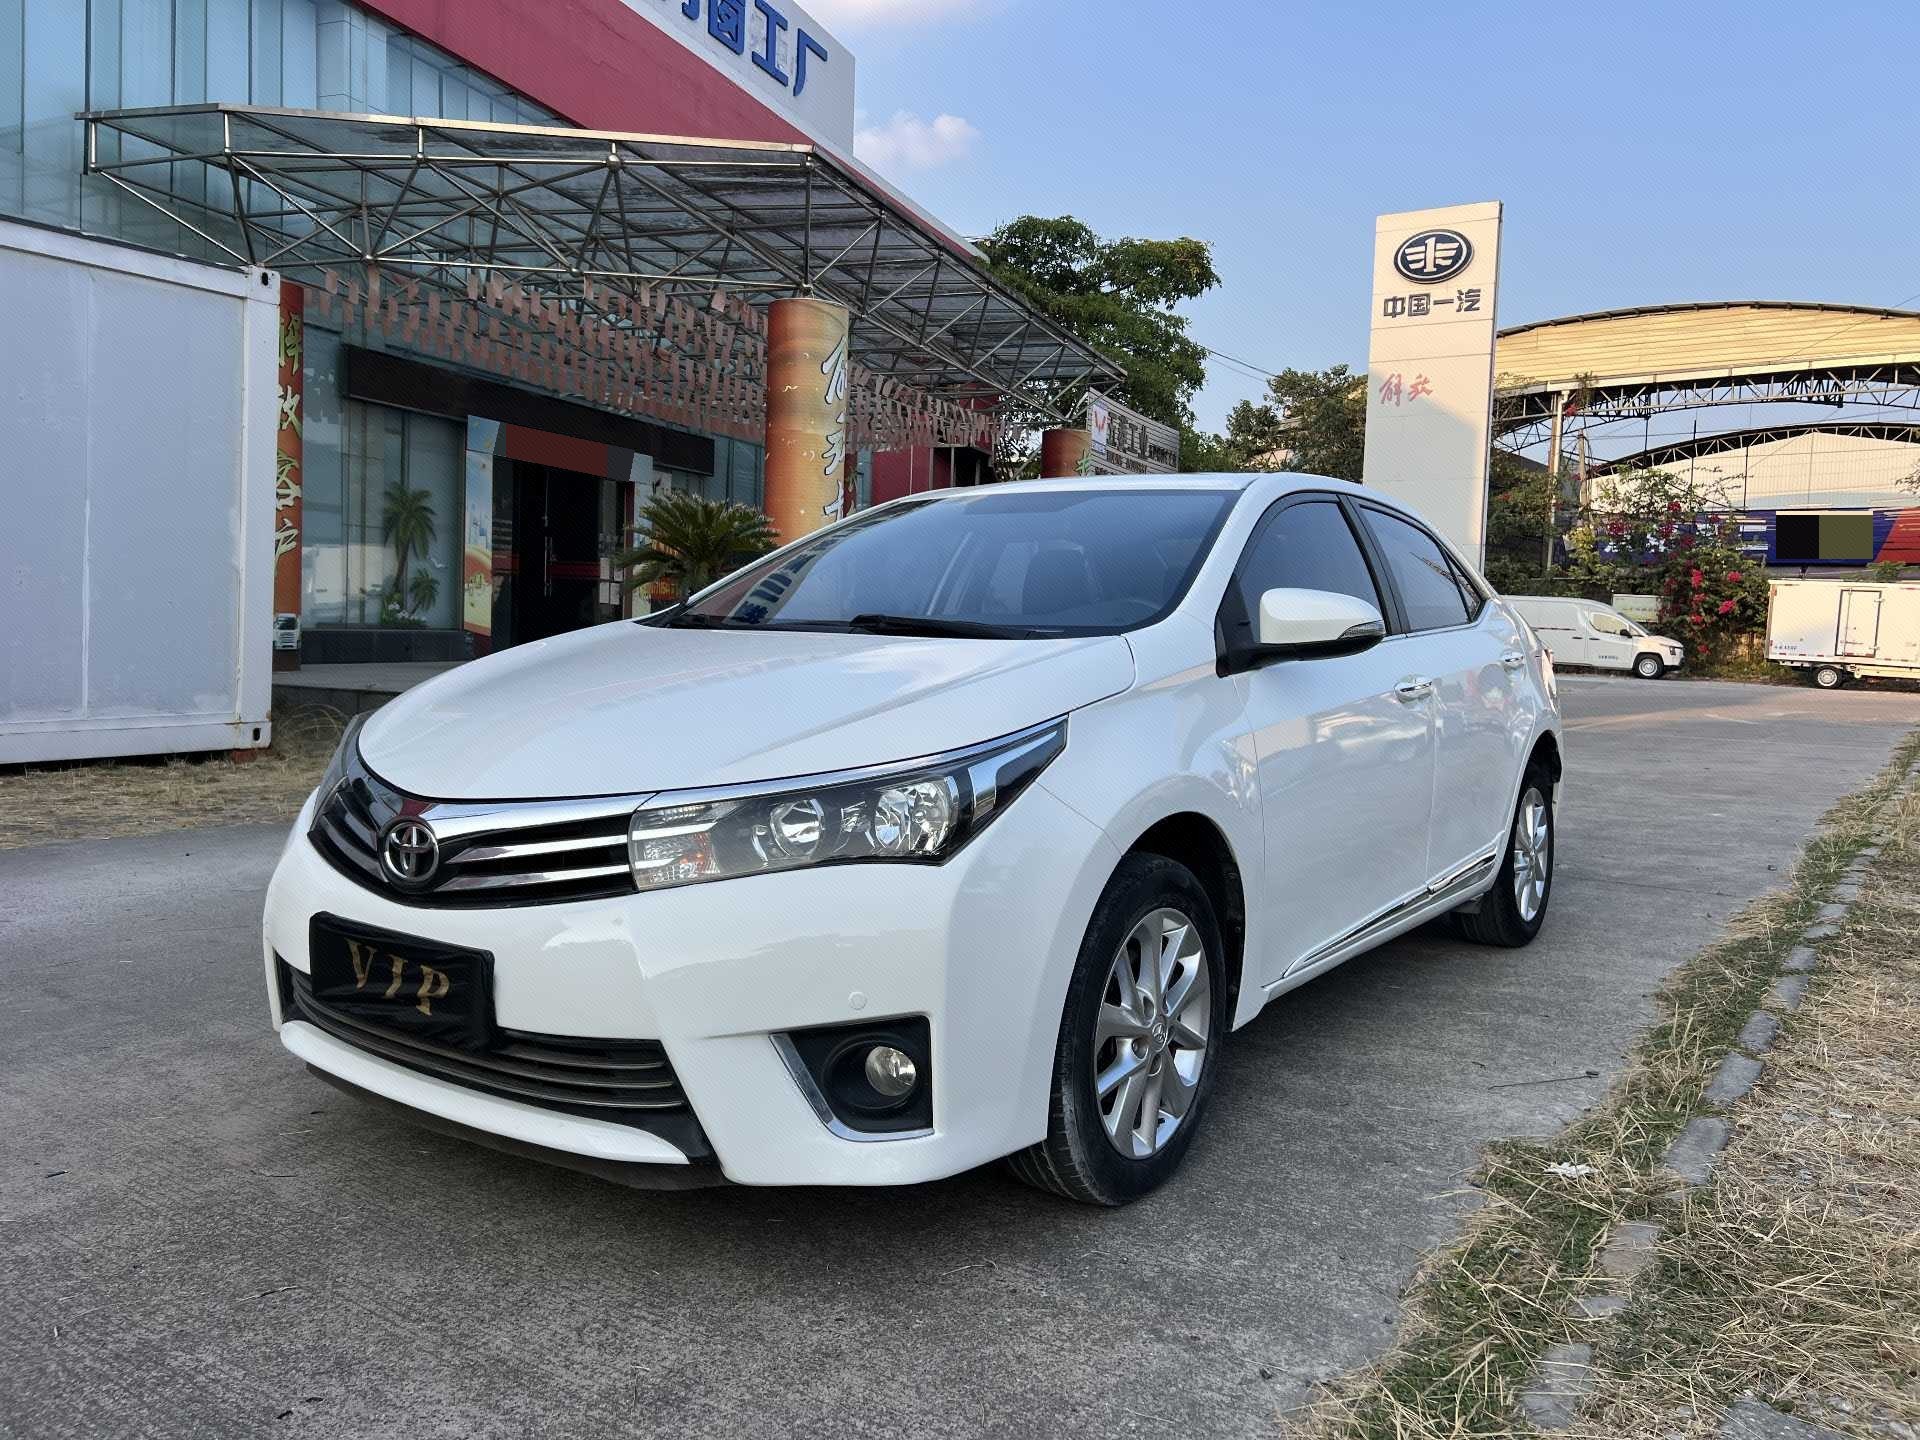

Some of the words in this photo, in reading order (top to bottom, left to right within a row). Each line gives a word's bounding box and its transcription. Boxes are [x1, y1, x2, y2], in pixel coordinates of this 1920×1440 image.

[681, 0, 828, 97] 窗工厂
[1383, 288, 1481, 318] 中国一汽
[1379, 373, 1433, 406] 解放
[346, 937, 450, 1016] VIP
